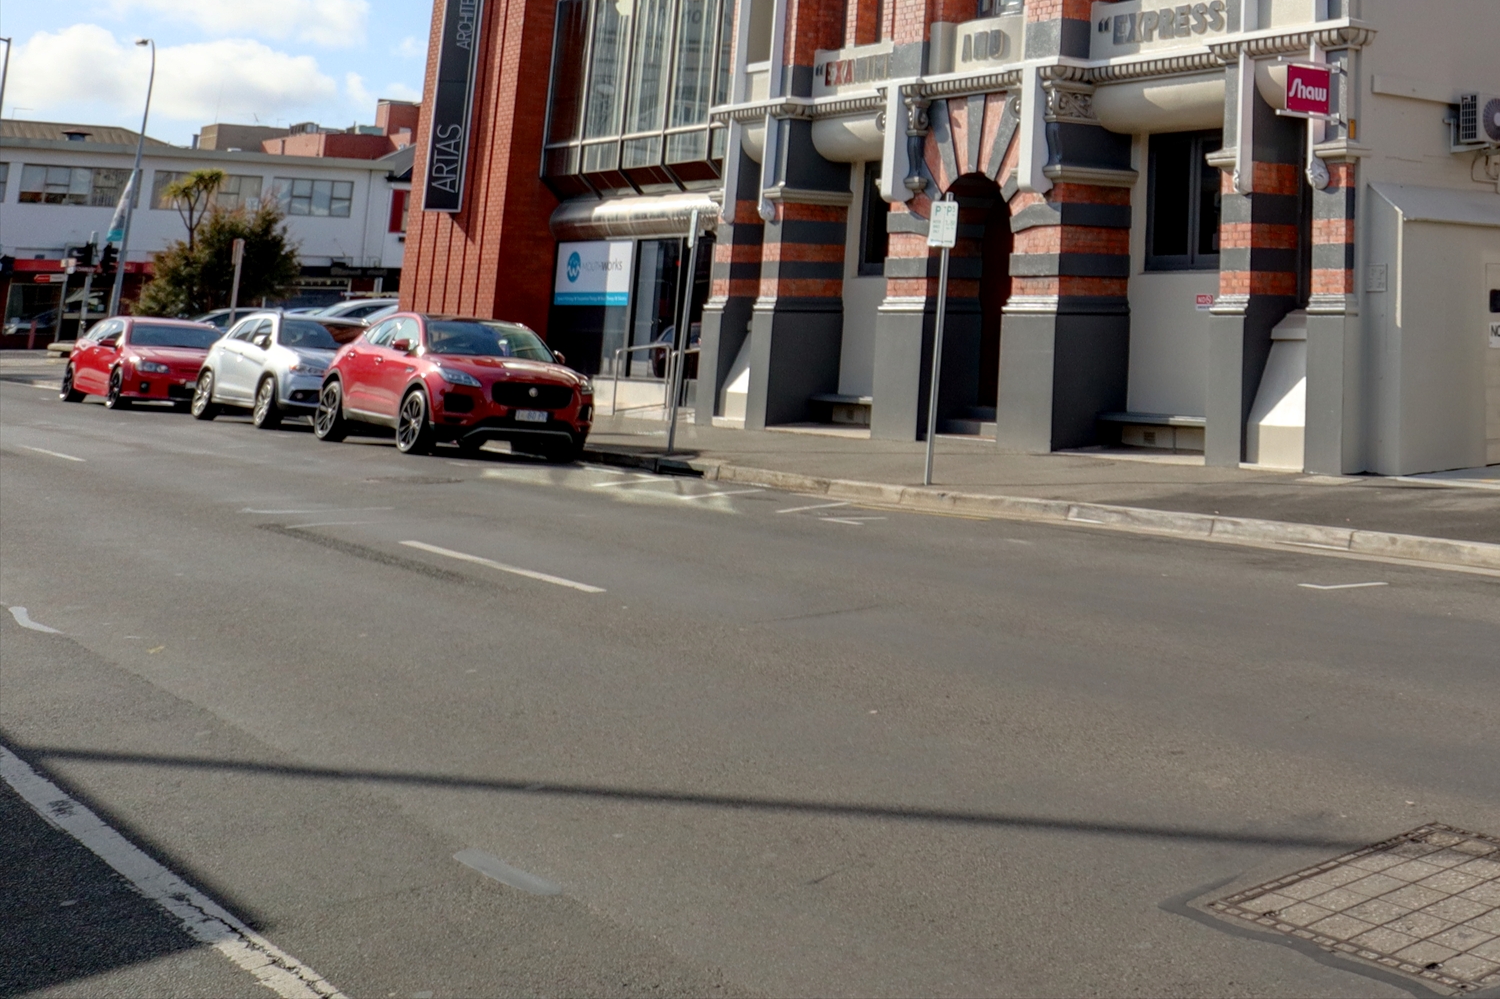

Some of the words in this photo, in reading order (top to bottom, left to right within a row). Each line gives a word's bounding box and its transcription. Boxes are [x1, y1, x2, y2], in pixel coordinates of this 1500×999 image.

[1289, 77, 1328, 102] Shaw
[431, 124, 462, 193] ARTAS
[935, 205, 942, 216] P
